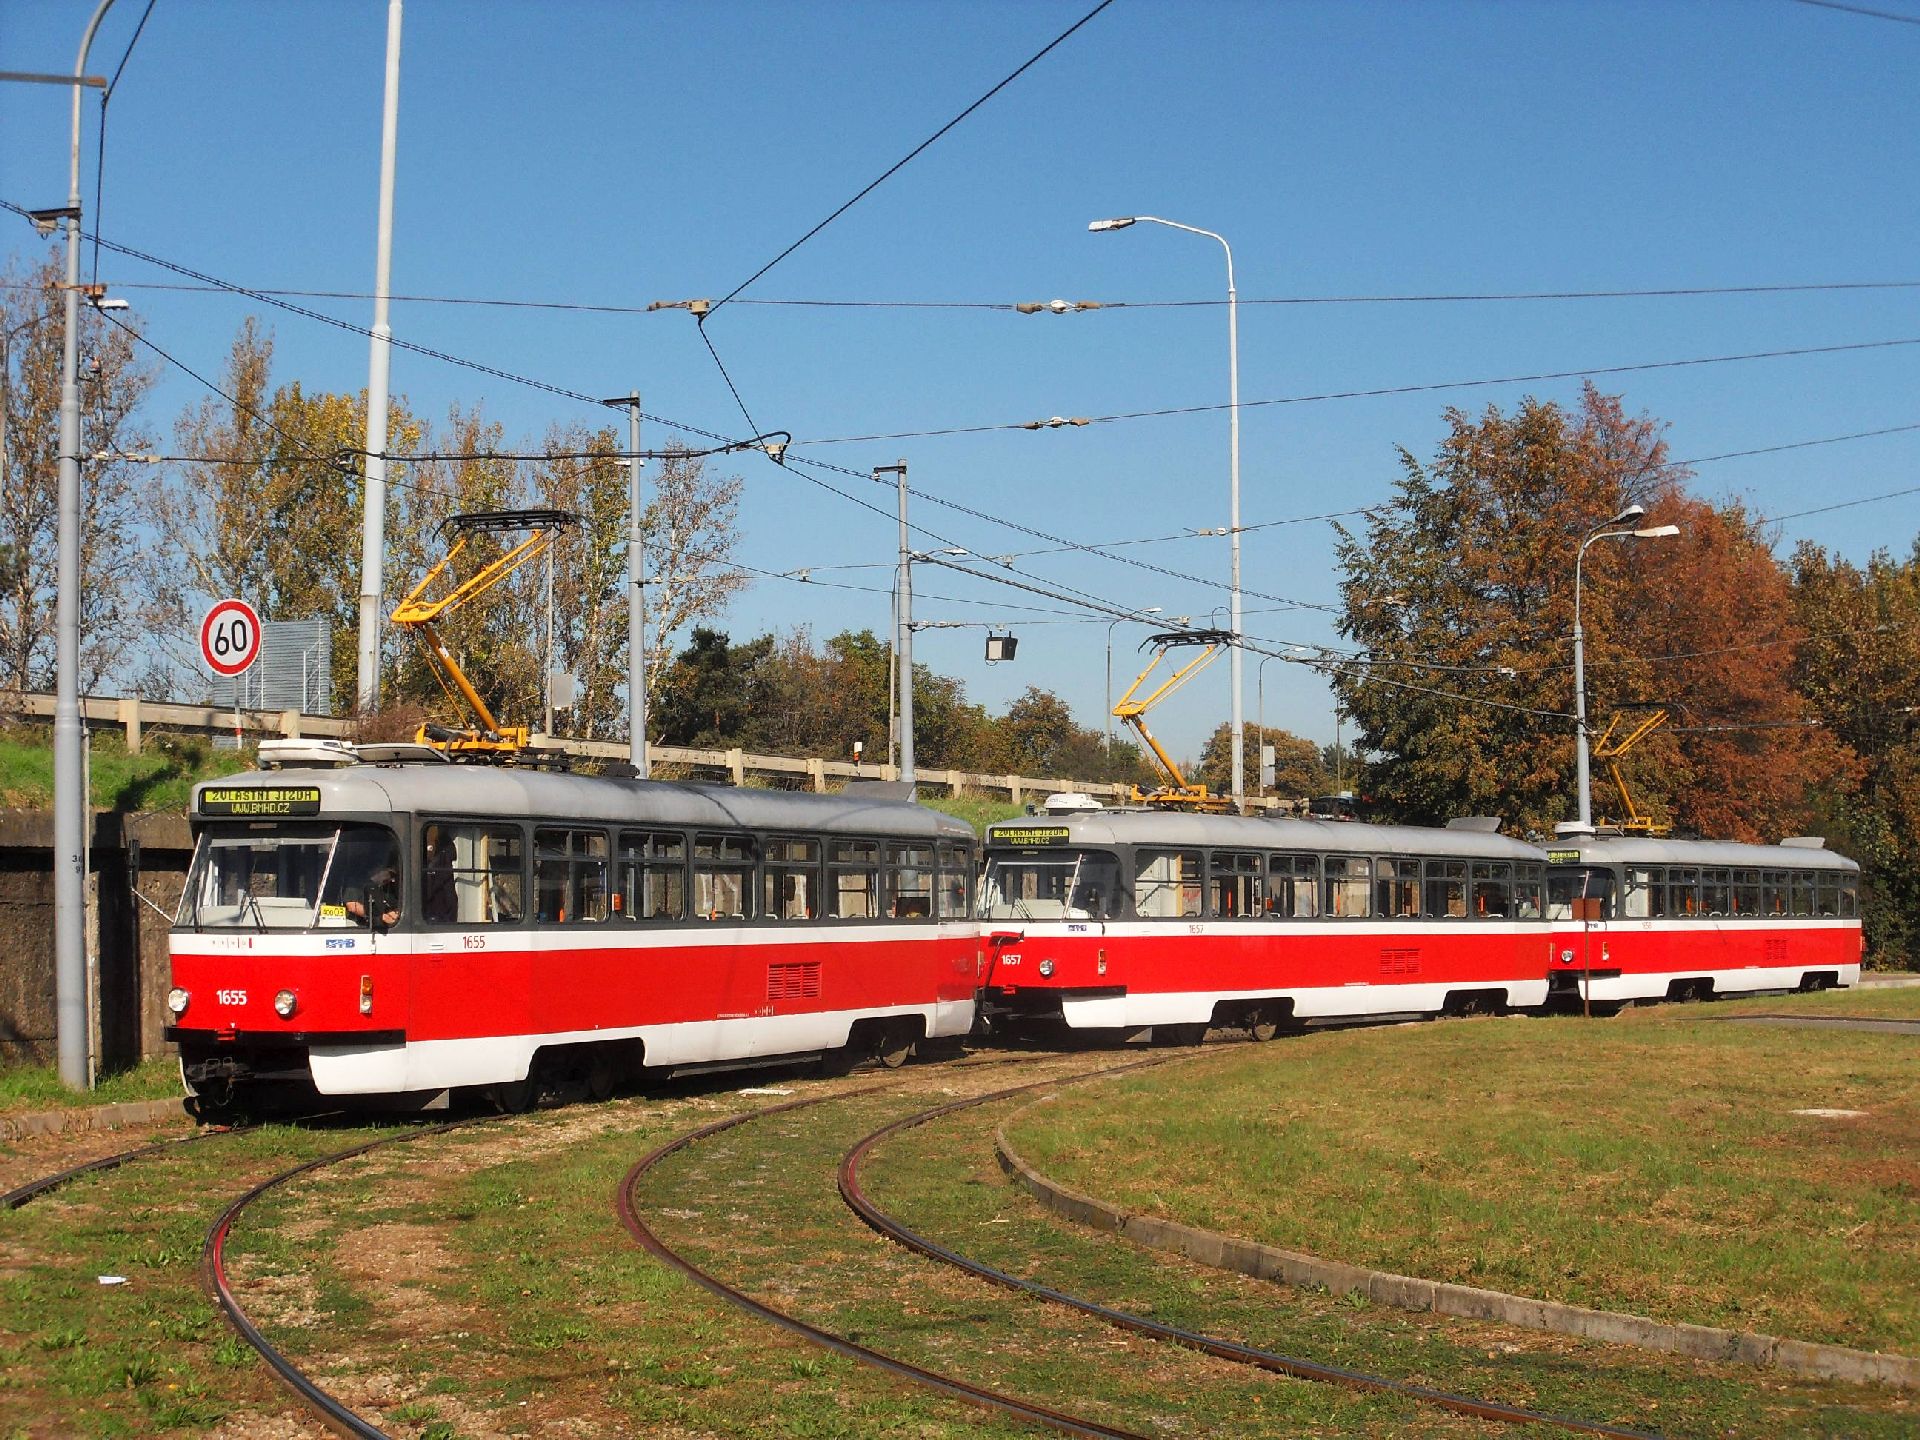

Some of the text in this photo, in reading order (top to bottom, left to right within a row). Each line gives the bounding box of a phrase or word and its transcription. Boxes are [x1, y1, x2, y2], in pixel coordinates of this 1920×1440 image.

[215, 620, 247, 656] 60
[231, 803, 290, 814] WWW.BMHD.CZ
[463, 935, 486, 949] 1655
[1001, 954, 1022, 966] 1657
[216, 990, 247, 1005] 1655
